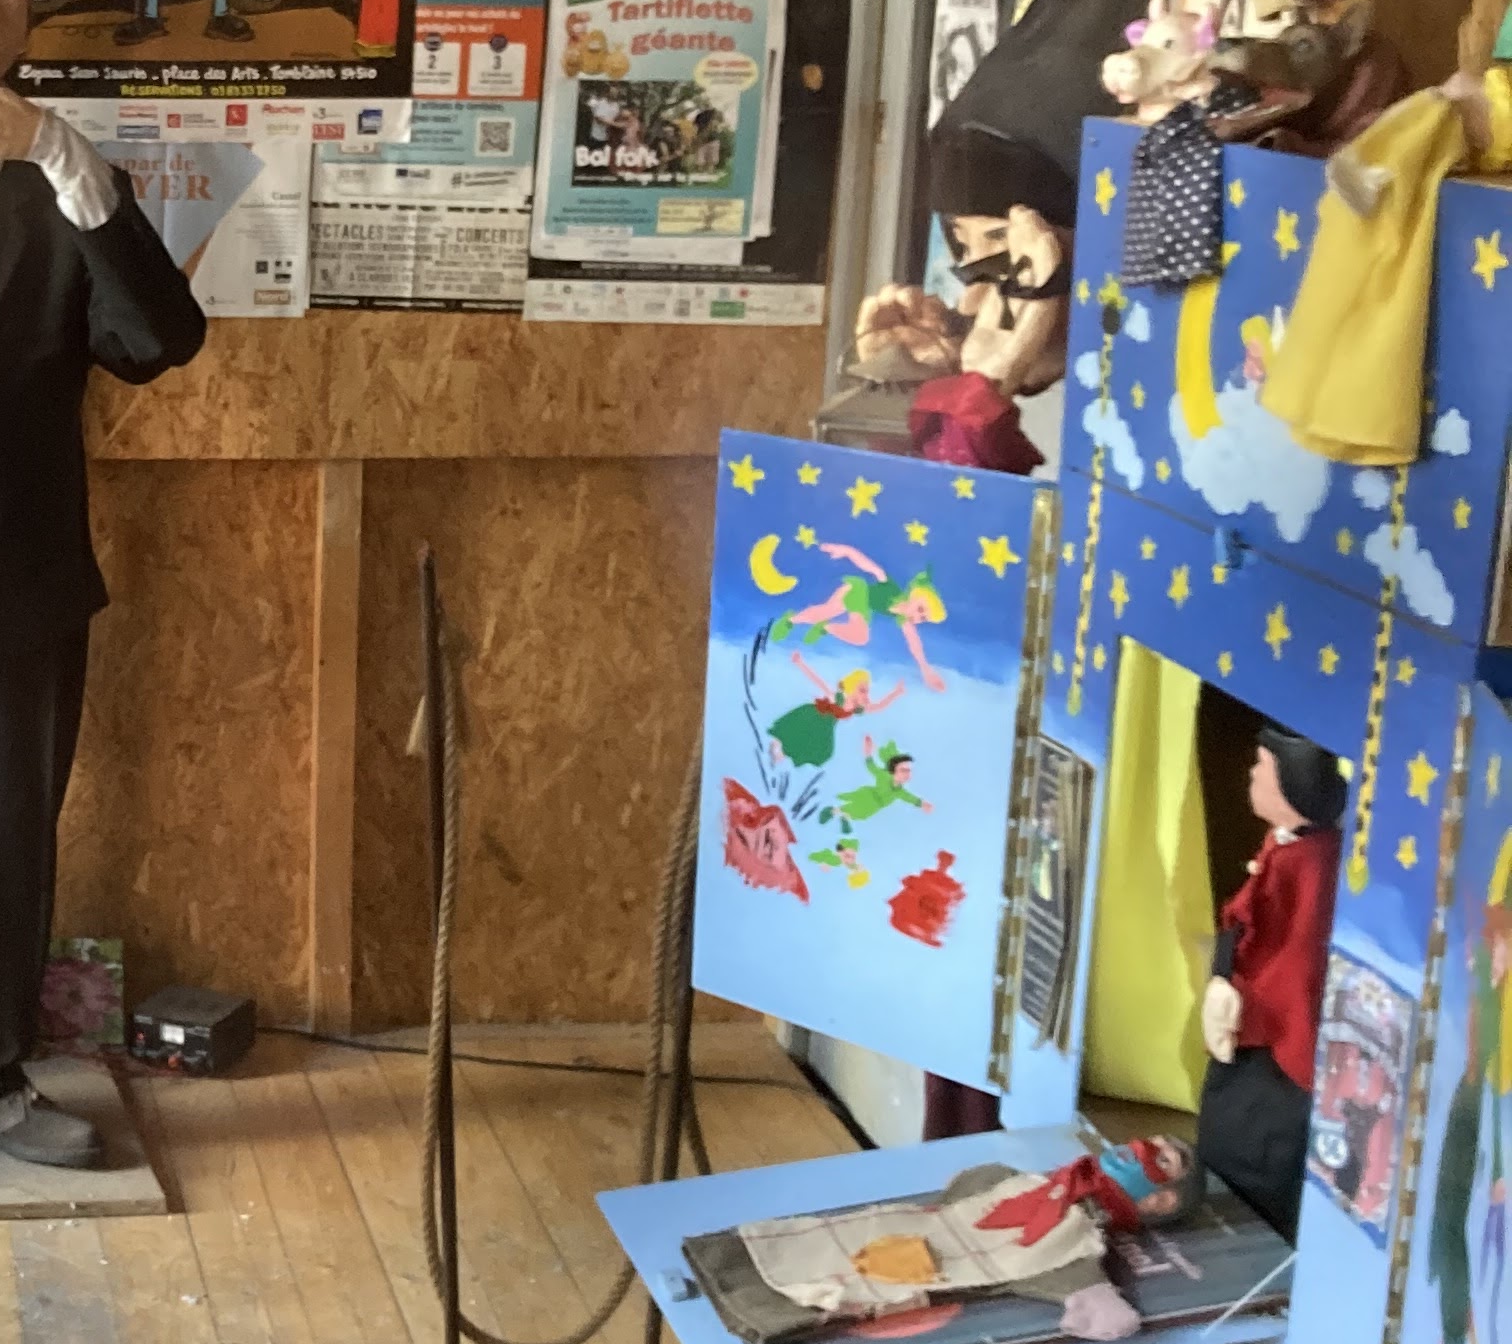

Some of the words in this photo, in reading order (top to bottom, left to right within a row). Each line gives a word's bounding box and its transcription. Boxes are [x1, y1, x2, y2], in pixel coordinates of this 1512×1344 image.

[631, 28, 735, 56] géante
[428, 55, 437, 70] 2
[162, 66, 201, 86] place
[269, 66, 336, 80] Tomblaine
[169, 152, 195, 170] de
[575, 146, 611, 168] Bal
[616, 146, 659, 168] folk
[456, 228, 524, 245] CONCERTS
